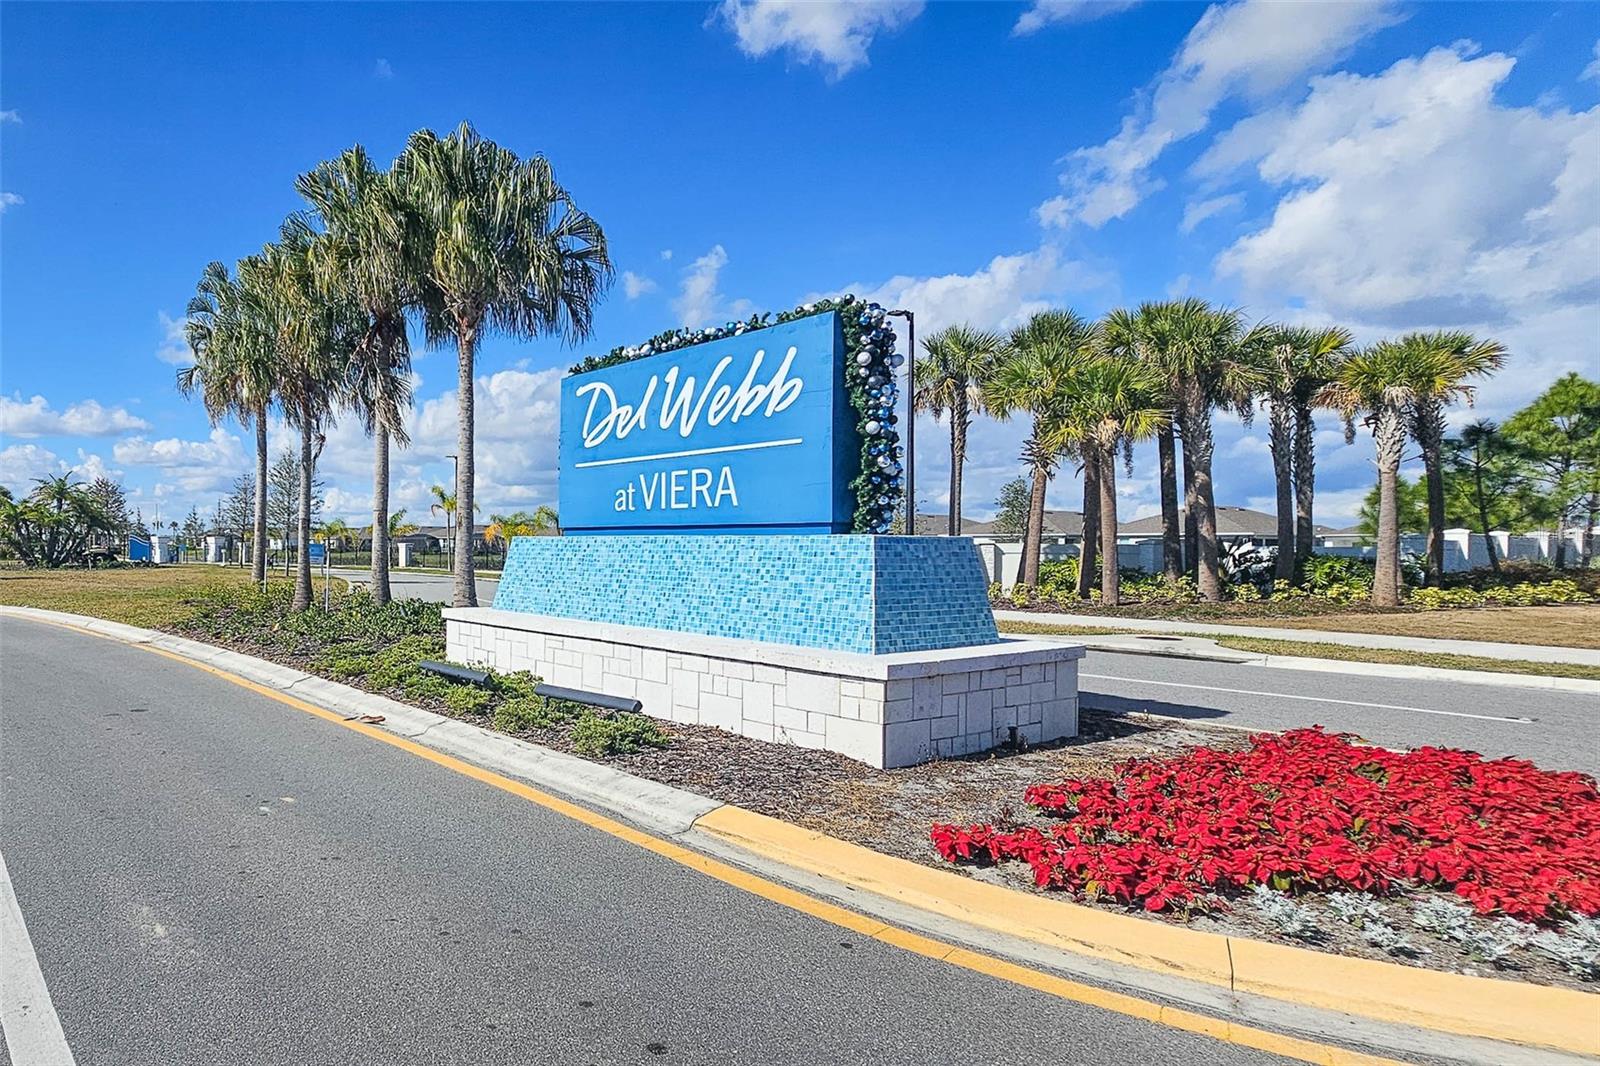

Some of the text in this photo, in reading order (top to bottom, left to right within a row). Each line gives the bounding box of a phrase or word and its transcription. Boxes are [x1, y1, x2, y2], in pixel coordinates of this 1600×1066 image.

[576, 346, 804, 448] Del Webb
[614, 466, 738, 511] at VIERA
